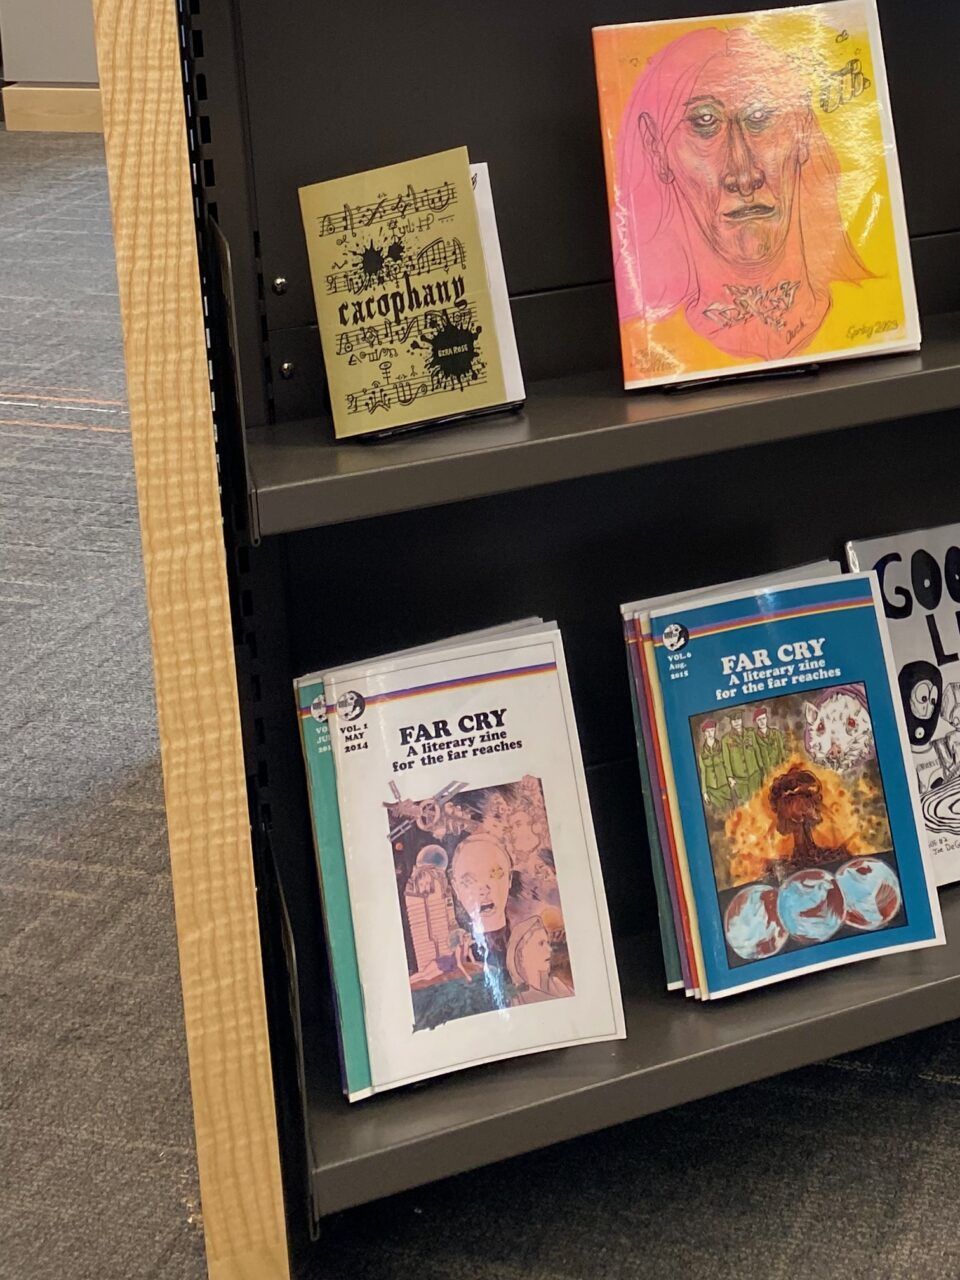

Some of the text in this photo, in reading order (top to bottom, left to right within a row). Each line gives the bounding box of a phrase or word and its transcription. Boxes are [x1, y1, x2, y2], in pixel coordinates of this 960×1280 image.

[338, 274, 470, 327] cacophany
[721, 637, 826, 676] FAR CRY
[729, 659, 826, 687] A literary zine
[716, 668, 842, 701] for the far reaches
[345, 732, 365, 742] MAY
[399, 708, 508, 746] FAR CRY
[406, 730, 508, 757] A literary zine
[344, 741, 369, 753] 2014
[392, 739, 523, 772] for the far reaches
